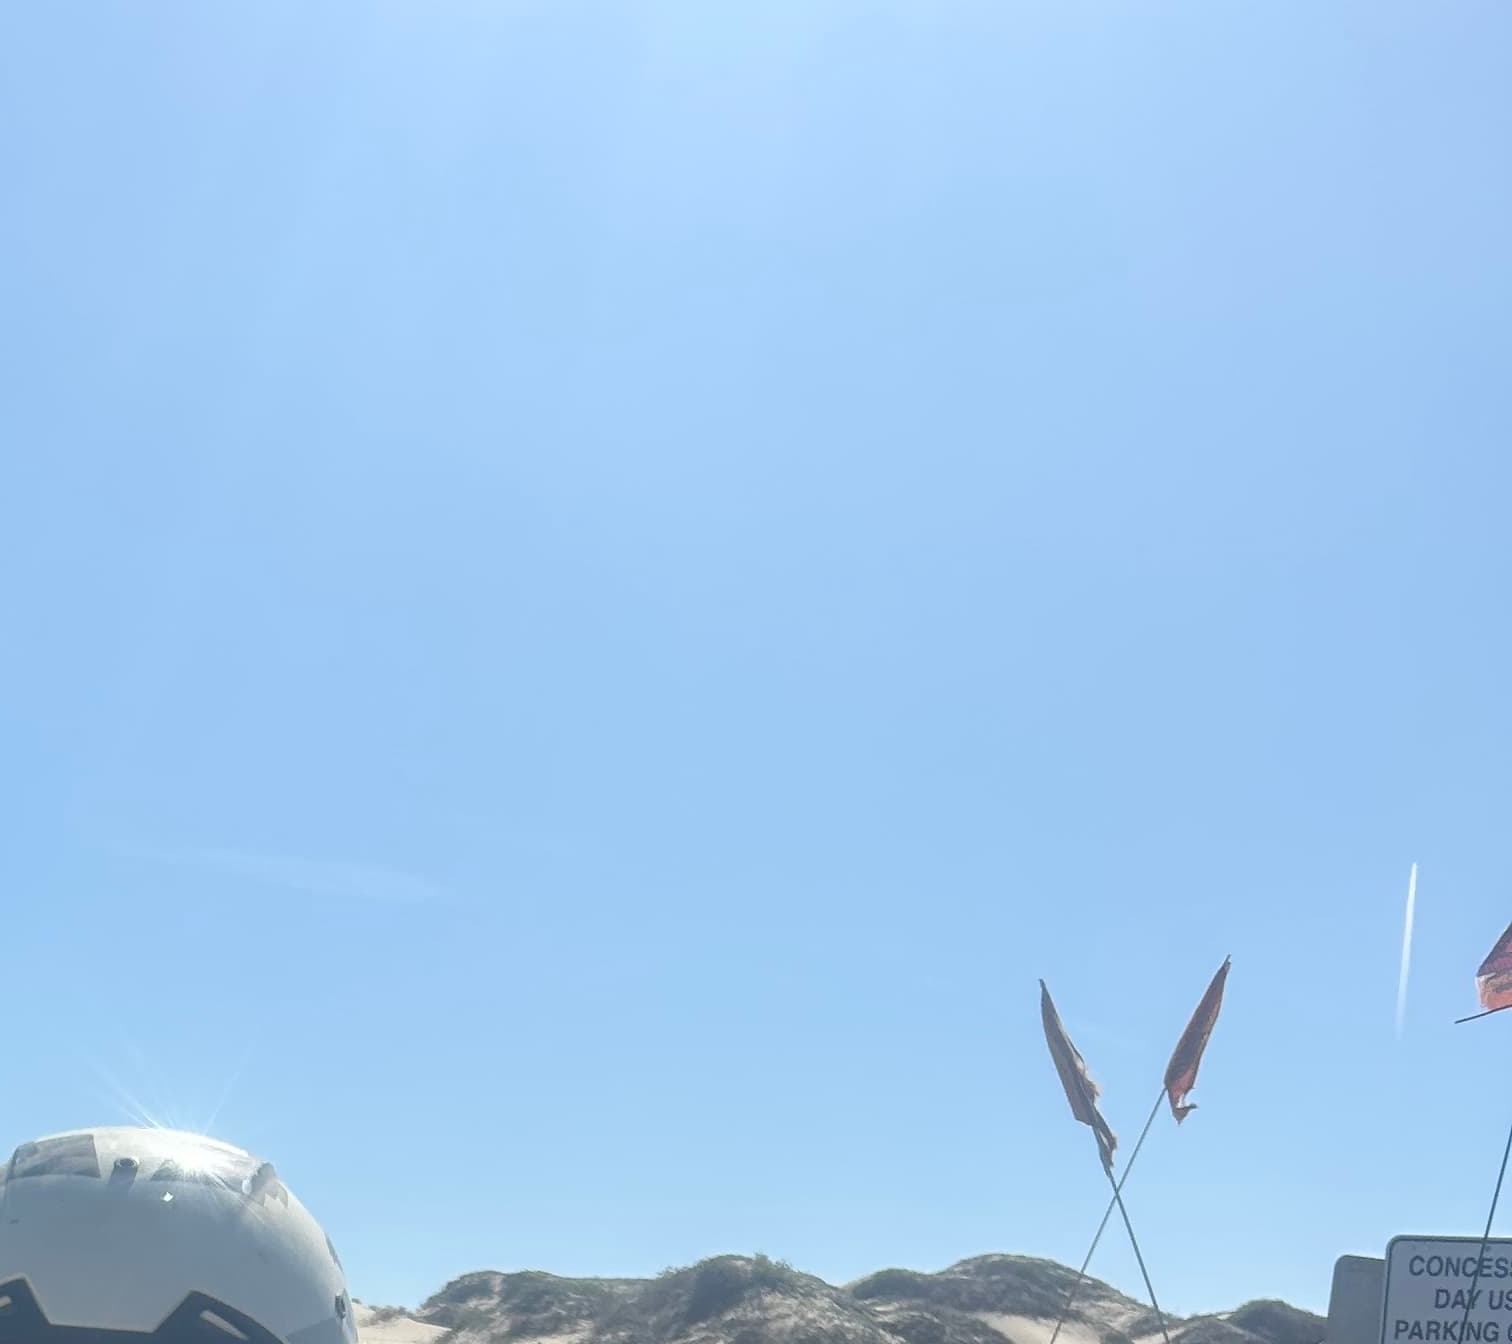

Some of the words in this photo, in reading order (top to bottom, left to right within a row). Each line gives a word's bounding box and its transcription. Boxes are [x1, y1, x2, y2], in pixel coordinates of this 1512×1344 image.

[1408, 1255, 1512, 1278] CONCES
[1434, 1288, 1482, 1310] DAY
[1394, 1319, 1499, 1342] PARKNG
